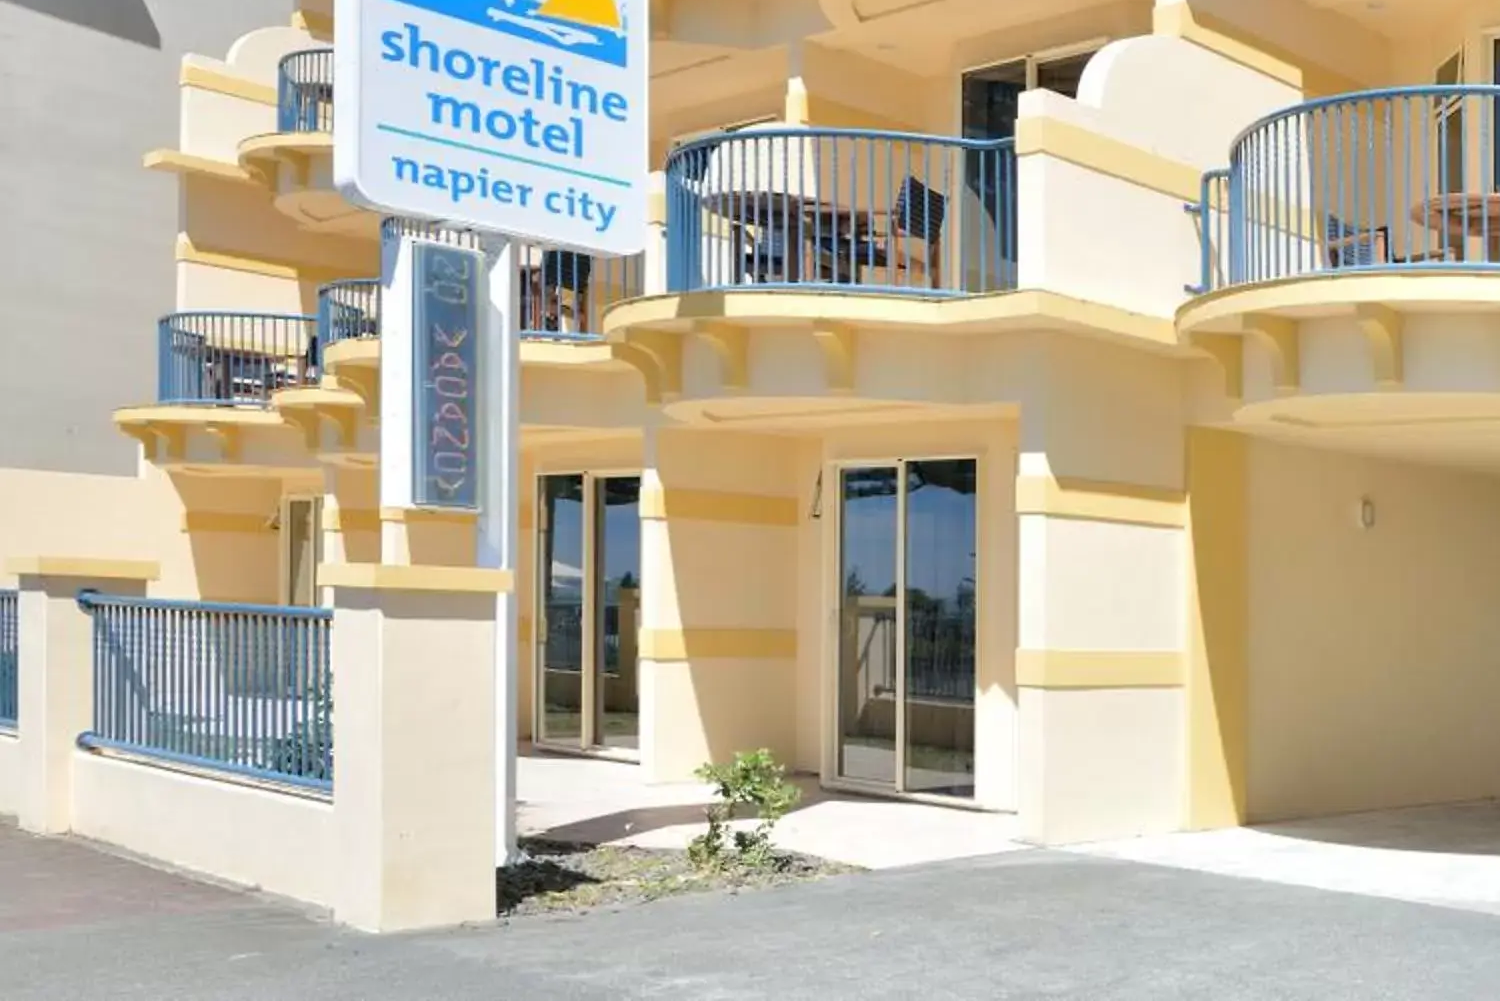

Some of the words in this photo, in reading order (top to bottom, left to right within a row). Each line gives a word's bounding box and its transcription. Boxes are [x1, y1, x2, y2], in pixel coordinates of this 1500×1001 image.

[381, 23, 627, 121] shoreline
[427, 92, 583, 157] motel
[391, 156, 533, 207] napier
[544, 186, 616, 232] city
[432, 255, 468, 303] NO
[430, 322, 468, 496] VACANCY
